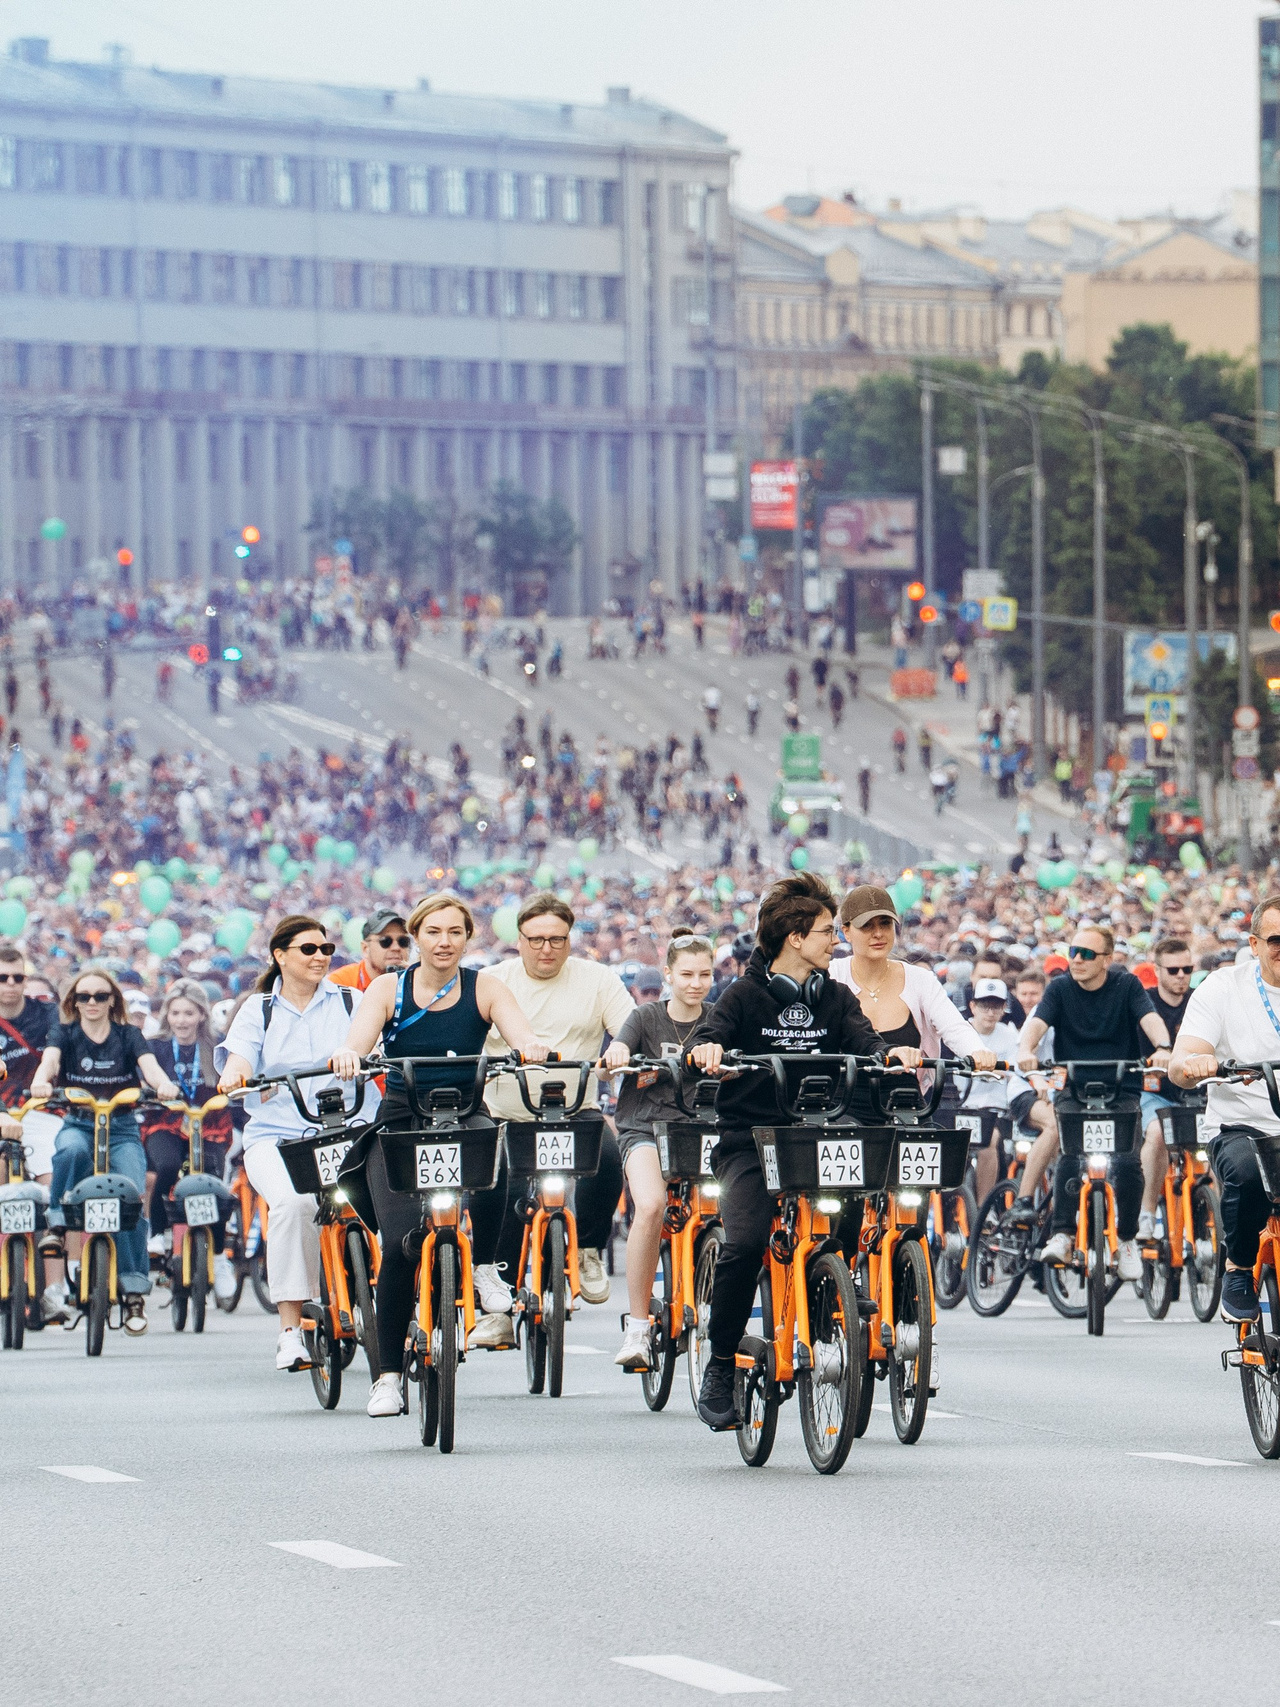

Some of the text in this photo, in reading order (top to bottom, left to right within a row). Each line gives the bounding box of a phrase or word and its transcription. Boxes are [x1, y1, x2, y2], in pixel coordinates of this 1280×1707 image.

[1084, 1124, 1113, 1136] АА0
[538, 1135, 572, 1150] АА7
[418, 1147, 458, 1165] АА7
[539, 1152, 573, 1166] 06Н
[820, 1143, 860, 1162] АА0
[900, 1146, 939, 1162] АА7
[419, 1166, 460, 1184] 56Х
[822, 1164, 861, 1182] 47К
[901, 1165, 940, 1181] 59Т
